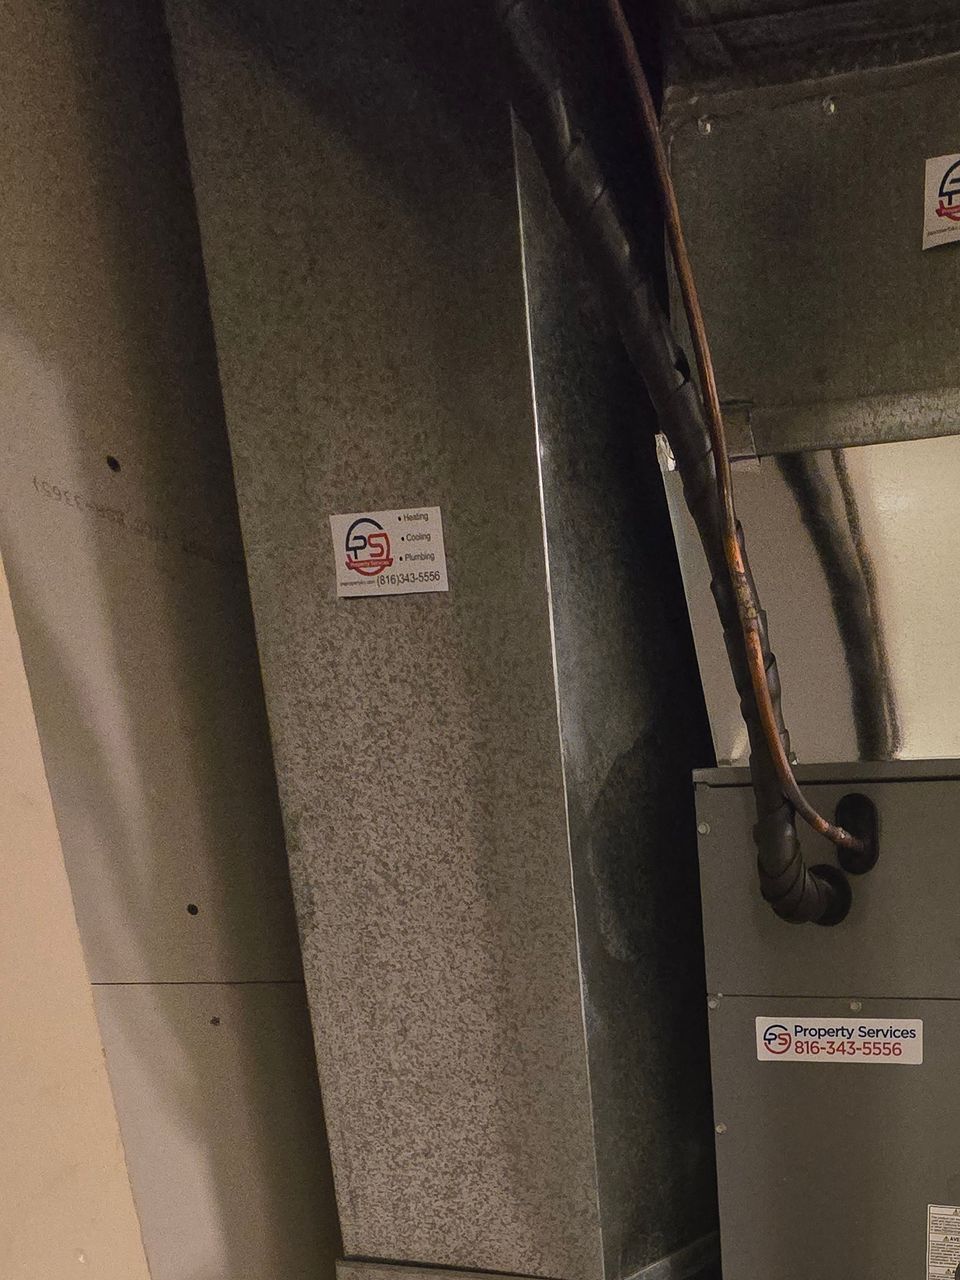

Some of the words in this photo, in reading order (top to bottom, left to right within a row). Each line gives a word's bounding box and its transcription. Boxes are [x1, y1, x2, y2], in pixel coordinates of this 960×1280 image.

[403, 513, 429, 522] Heating
[405, 533, 431, 542] Cooling
[404, 552, 435, 562] Plumbing
[376, 570, 441, 588] (816)343-5556
[794, 1024, 856, 1040] Property
[858, 1025, 917, 1039] Services
[794, 1041, 902, 1057] 816-343-5556
